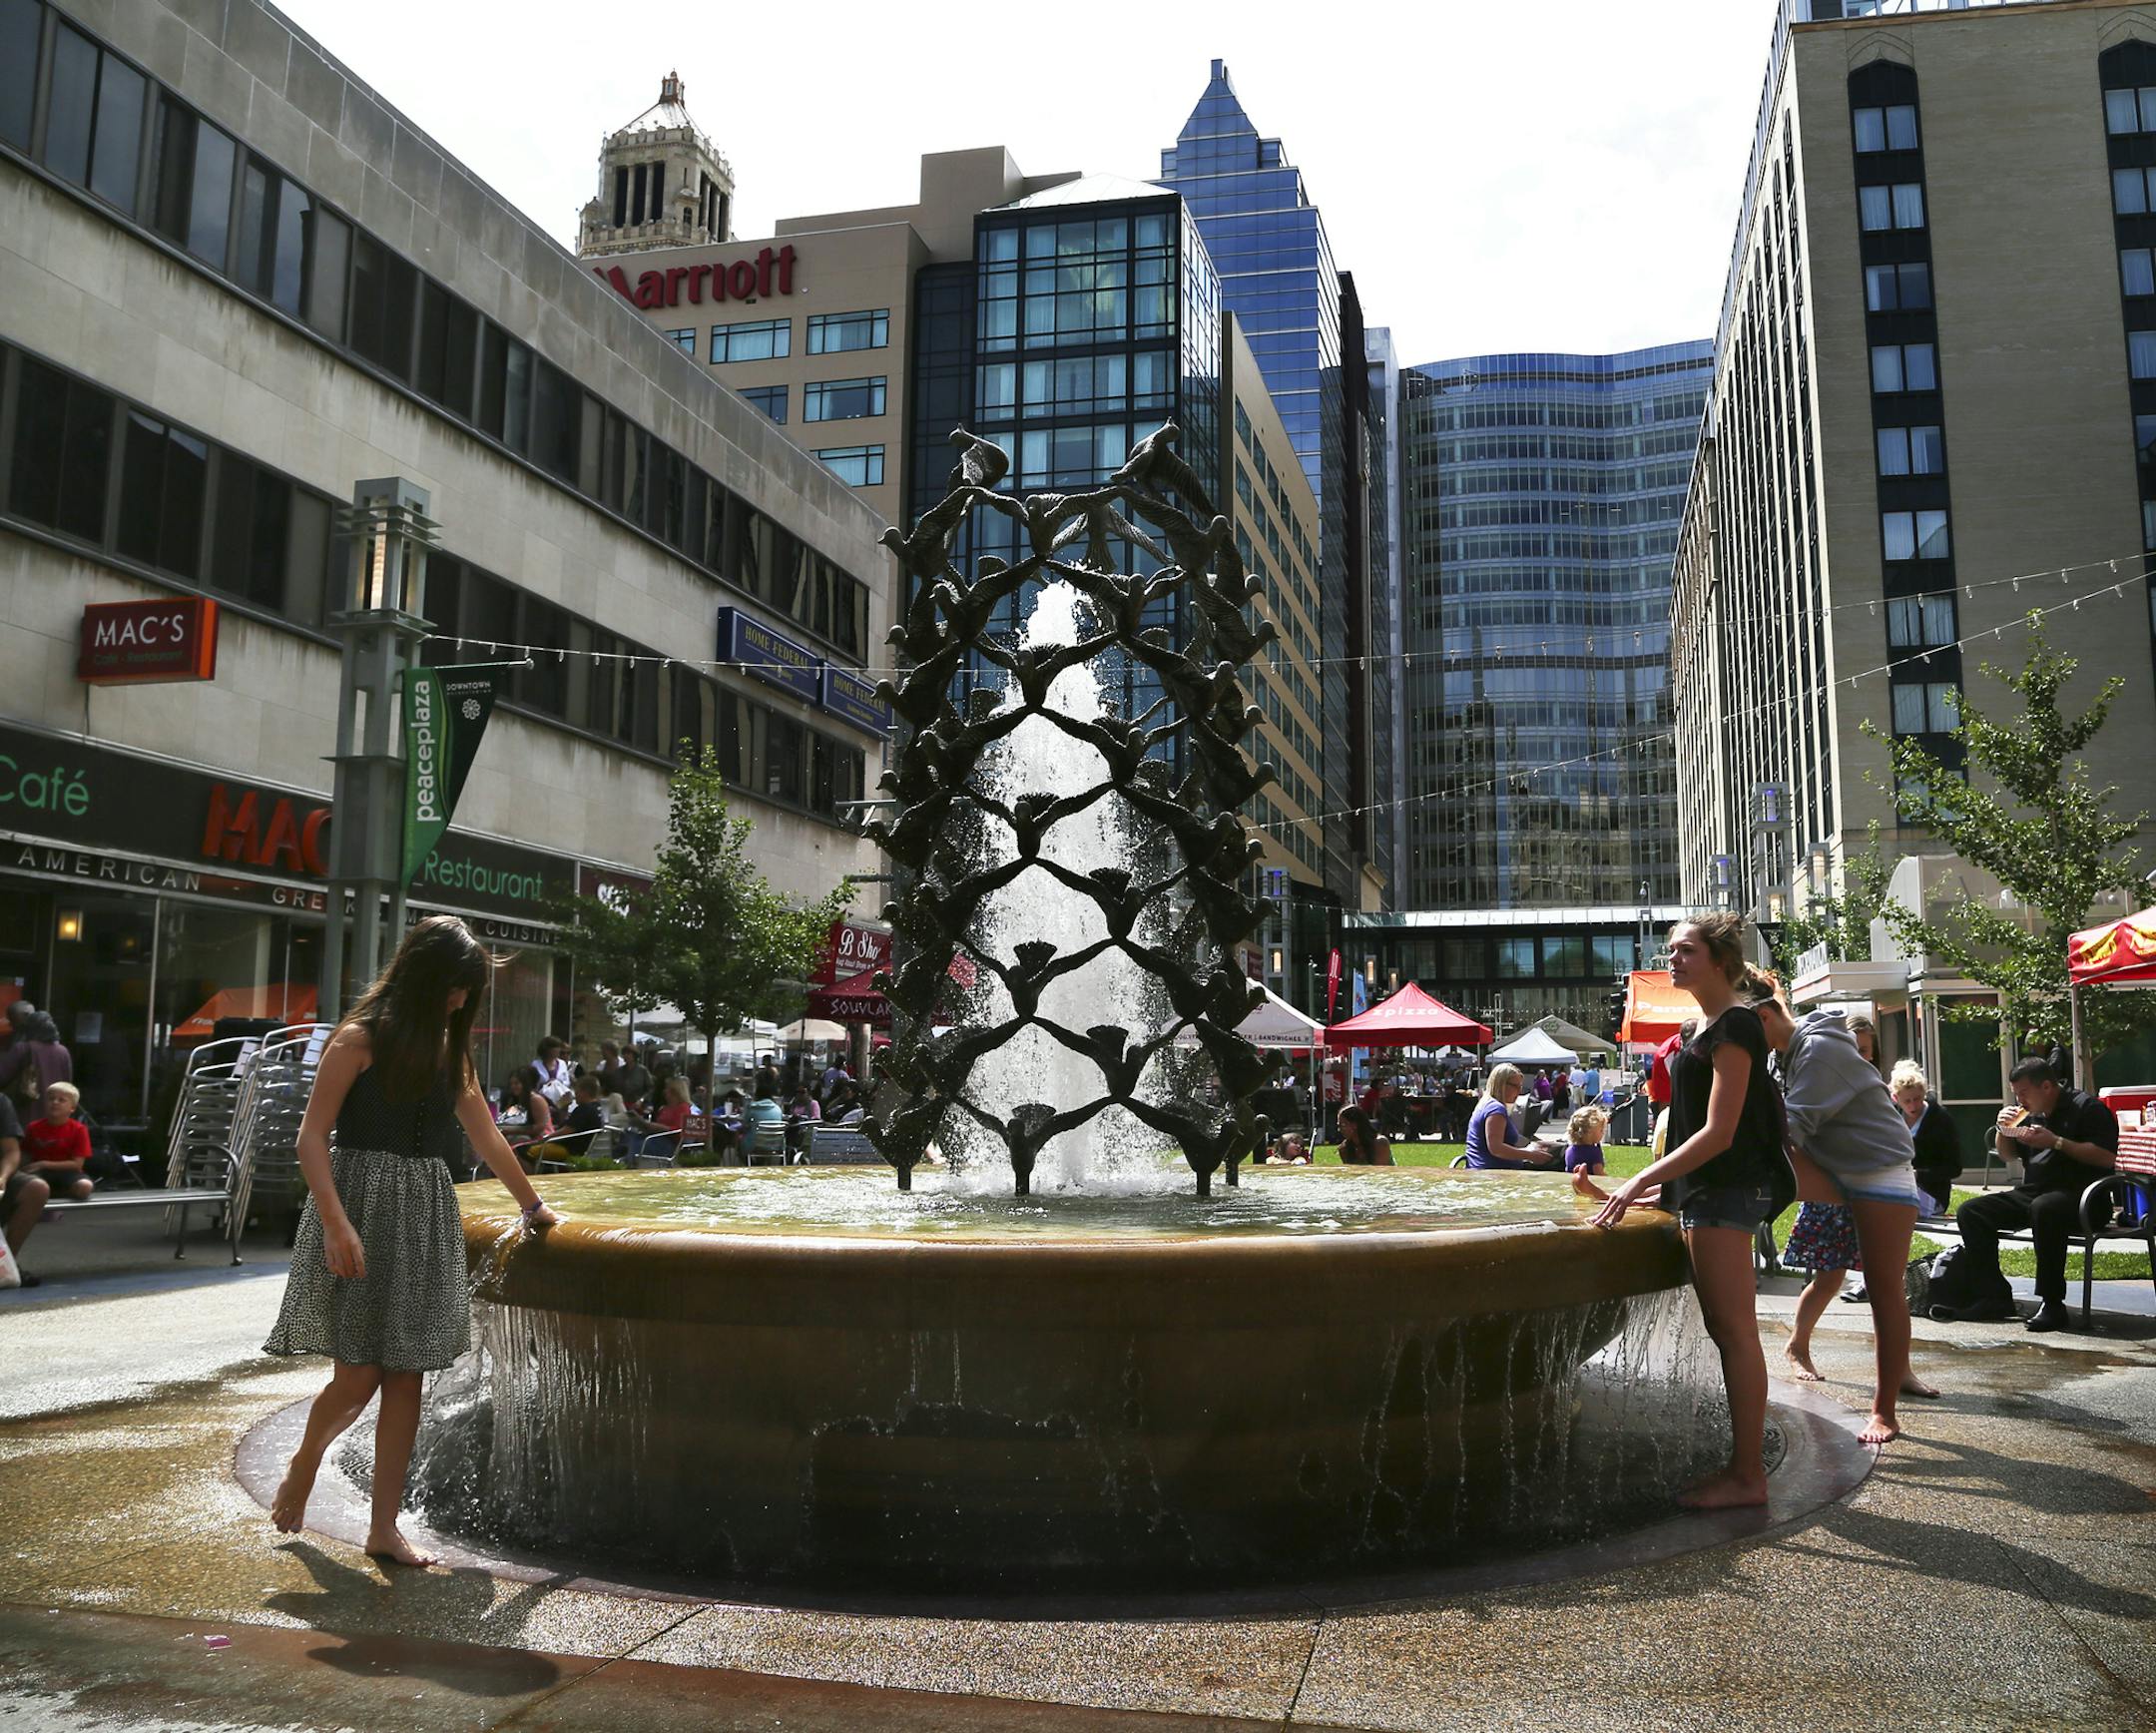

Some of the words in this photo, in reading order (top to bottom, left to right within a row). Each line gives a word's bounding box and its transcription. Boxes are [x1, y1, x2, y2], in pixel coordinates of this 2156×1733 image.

[95, 614, 184, 647] MAC'S
[745, 626, 770, 650] HOME
[773, 642, 808, 672] FEDERAL
[446, 681, 491, 691] DOWNTOWN
[833, 674, 853, 696] HOME
[410, 681, 441, 822] peaceplaza
[18, 846, 200, 891] AMERICAN
[424, 851, 542, 900] Restaurant
[271, 886, 355, 913] GREK
[486, 920, 561, 943] CUISINE
[839, 928, 855, 956] B
